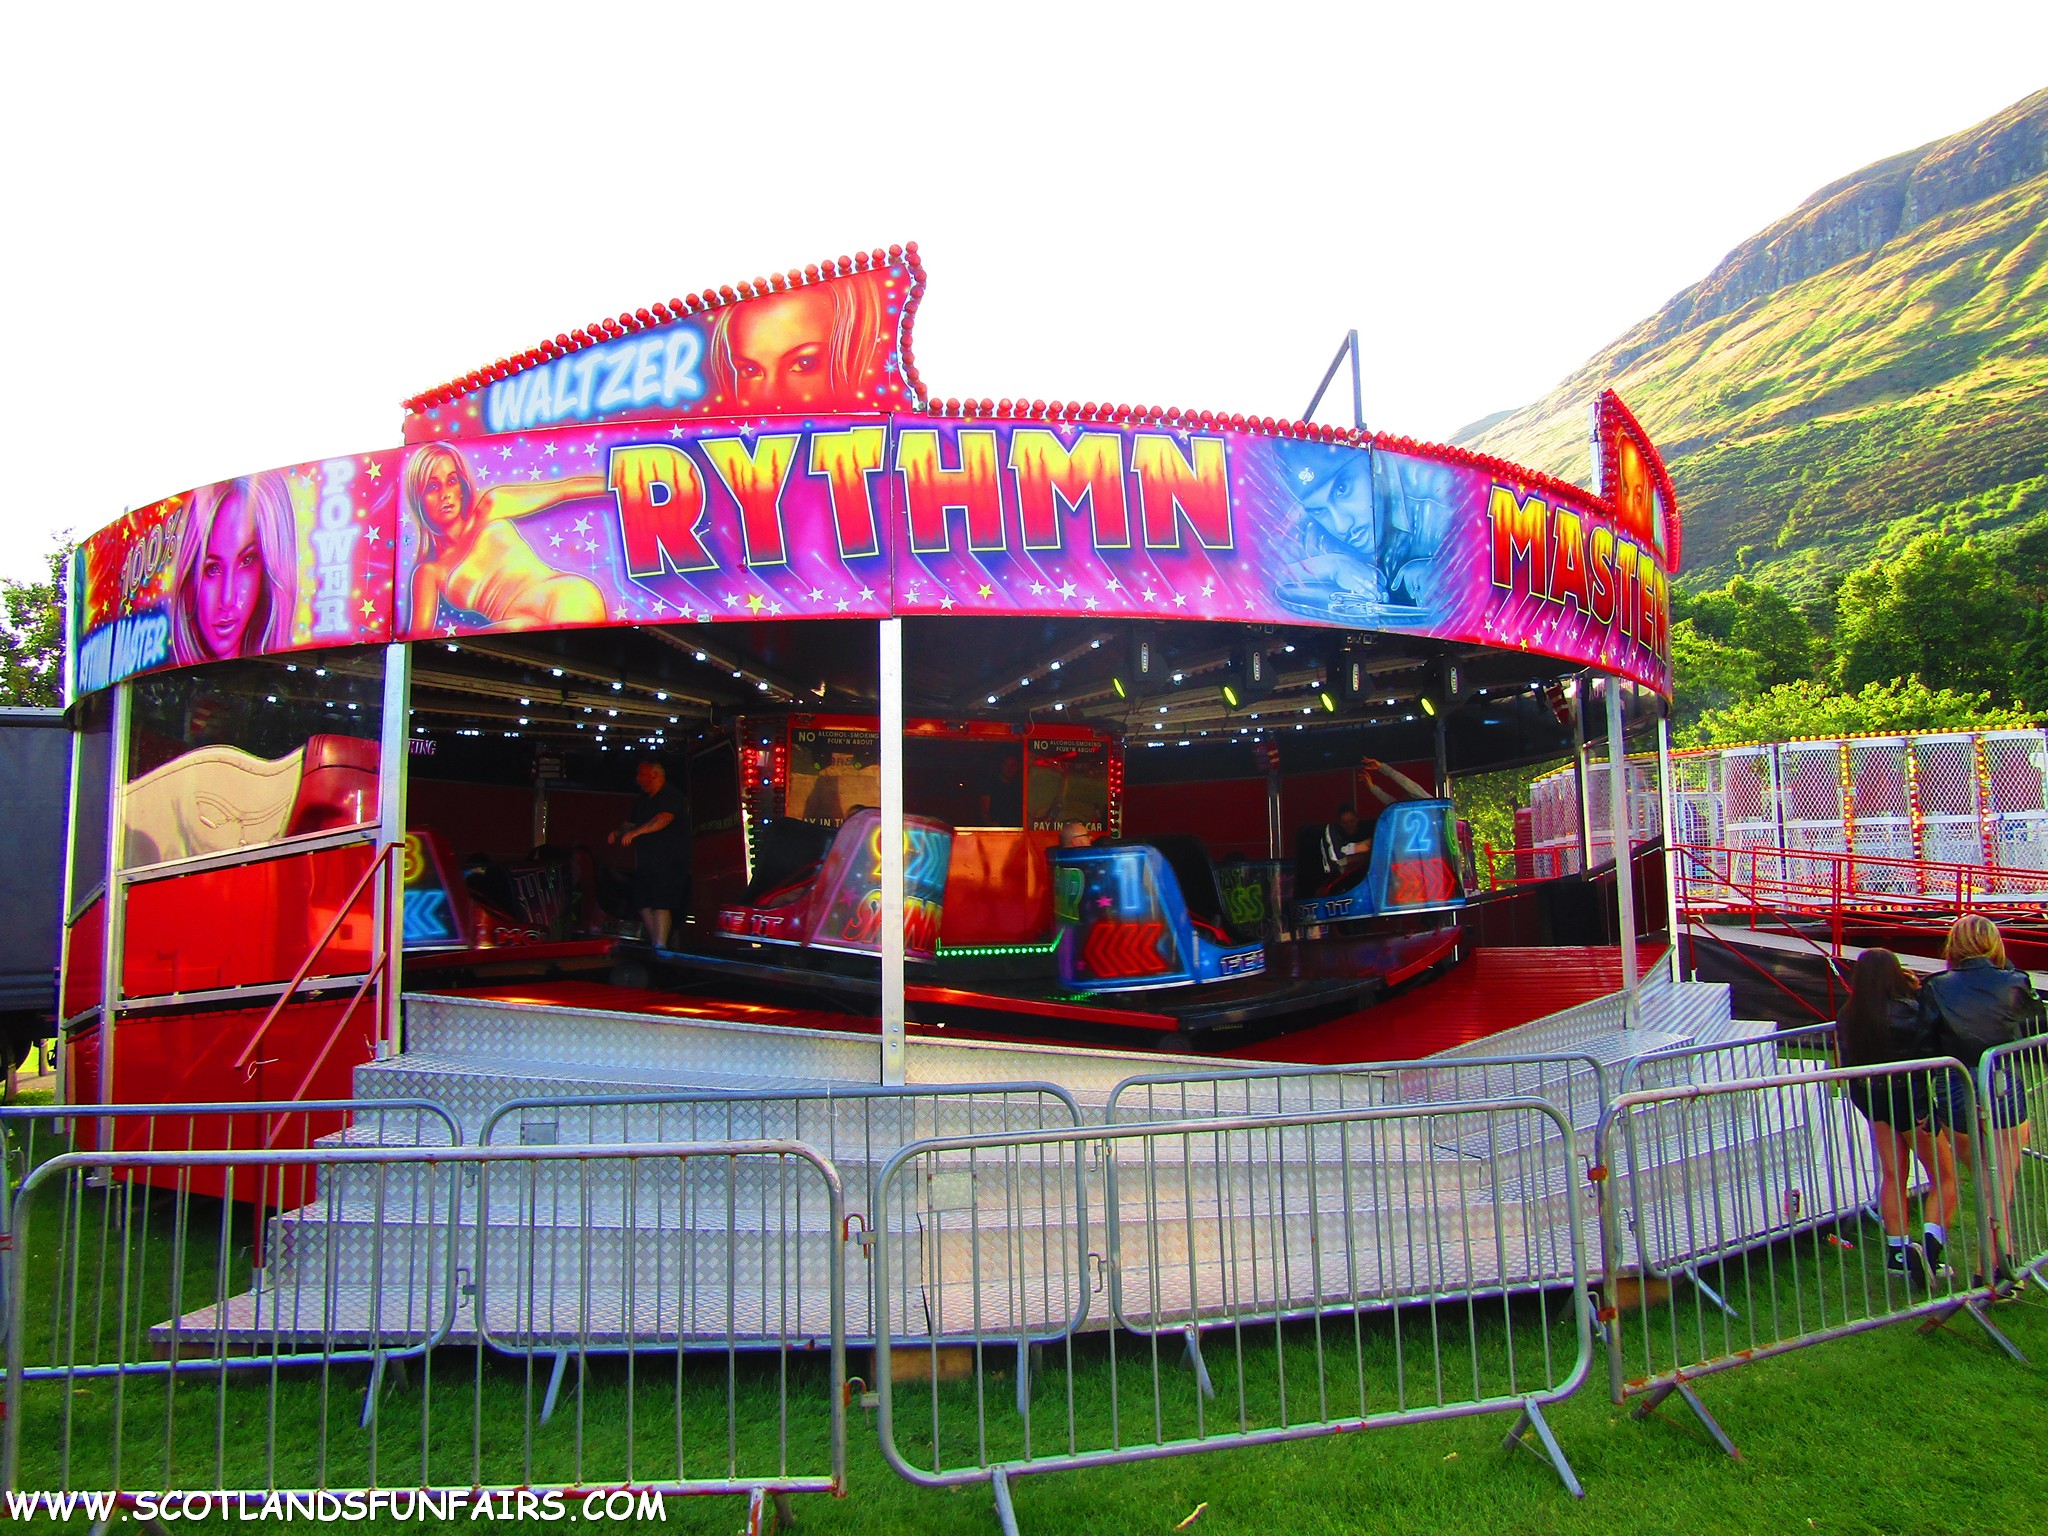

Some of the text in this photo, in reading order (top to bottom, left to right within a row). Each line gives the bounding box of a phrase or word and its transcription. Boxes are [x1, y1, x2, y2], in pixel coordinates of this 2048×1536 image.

[492, 328, 702, 429] WALTZER
[608, 426, 1234, 578] RYTHMN
[120, 509, 182, 597] 100%
[315, 460, 360, 634] POWER
[1487, 485, 1668, 666] MASTER
[798, 731, 816, 742] NO
[1033, 740, 1049, 750] NO
[1033, 822, 1103, 831] PAY IN CAR
[1403, 810, 1432, 852] 2
